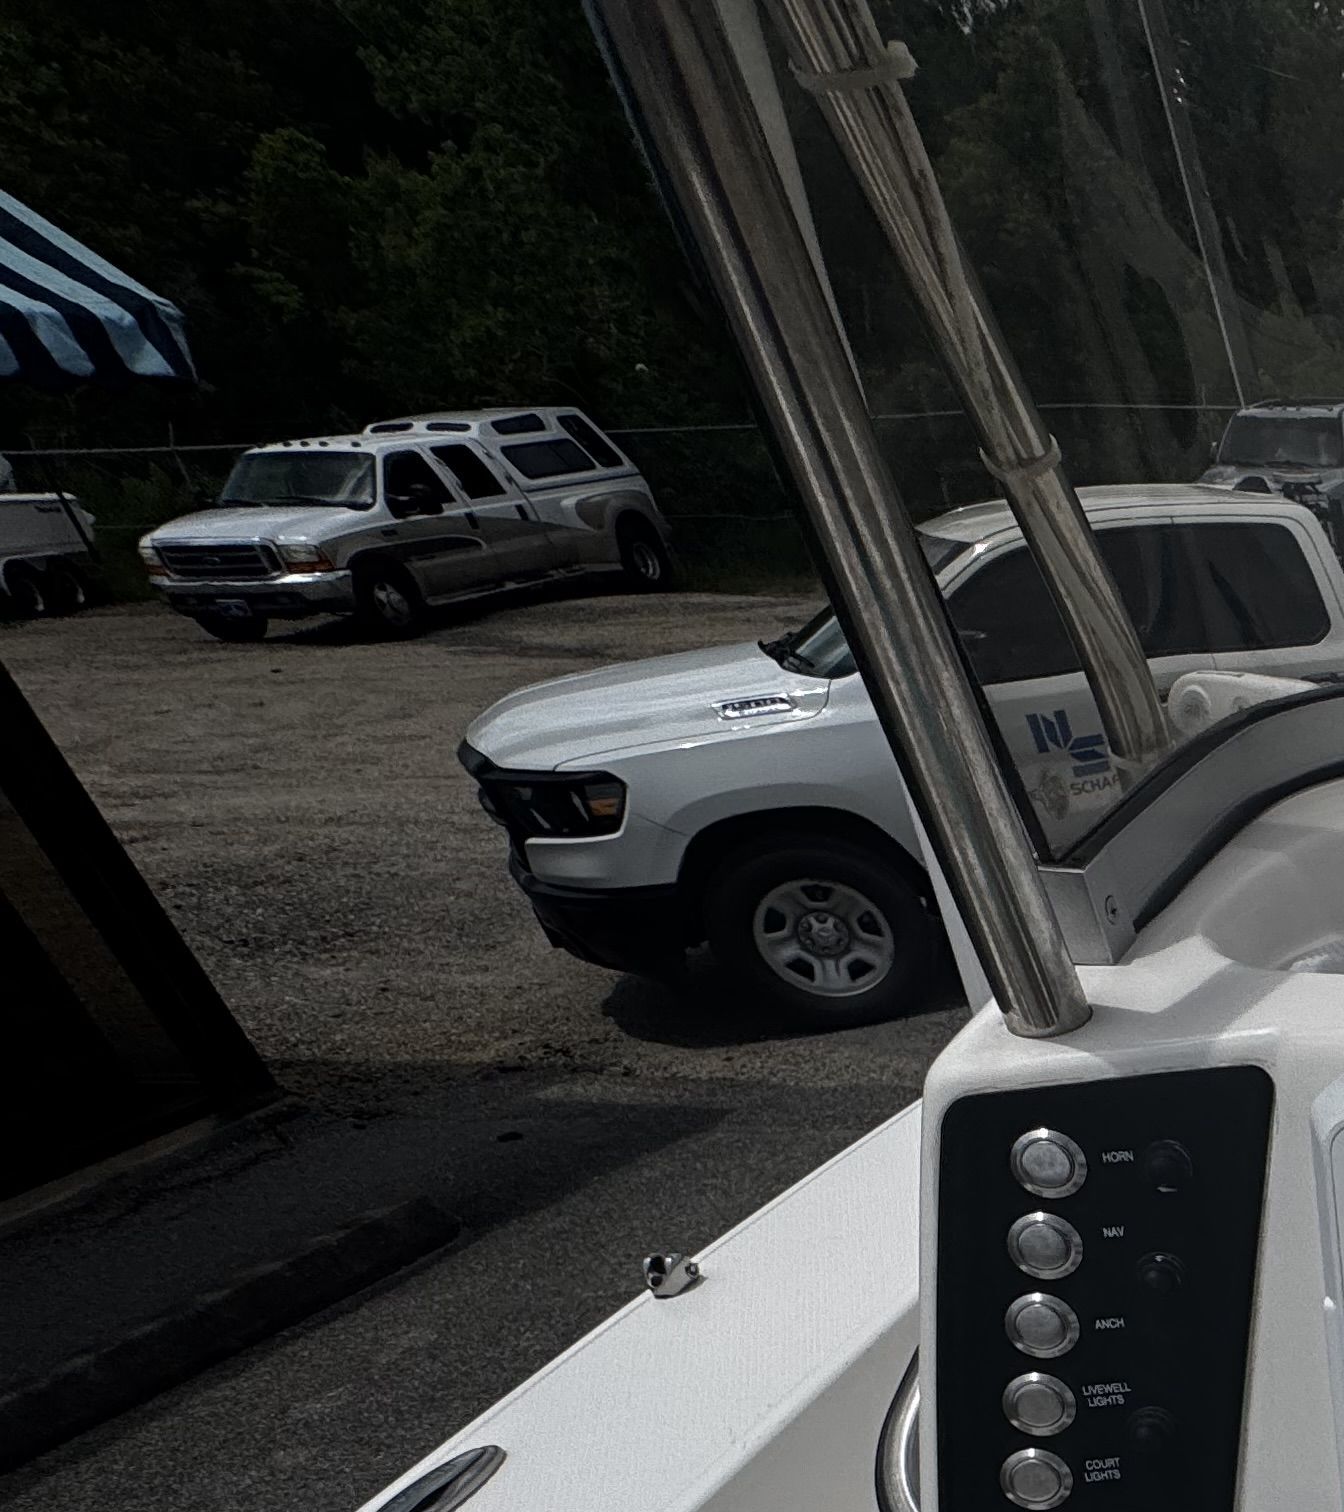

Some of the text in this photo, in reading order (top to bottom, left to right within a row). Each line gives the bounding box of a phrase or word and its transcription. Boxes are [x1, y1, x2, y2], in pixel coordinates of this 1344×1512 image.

[1102, 1151, 1134, 1163] HORN
[1102, 1226, 1125, 1238] NAV
[1095, 1318, 1125, 1330] ANCH
[1082, 1382, 1131, 1396] LIVEWELL
[1087, 1394, 1125, 1408] LIGHTS
[1085, 1457, 1120, 1471] COURT
[1084, 1469, 1121, 1482] LIGHTS
